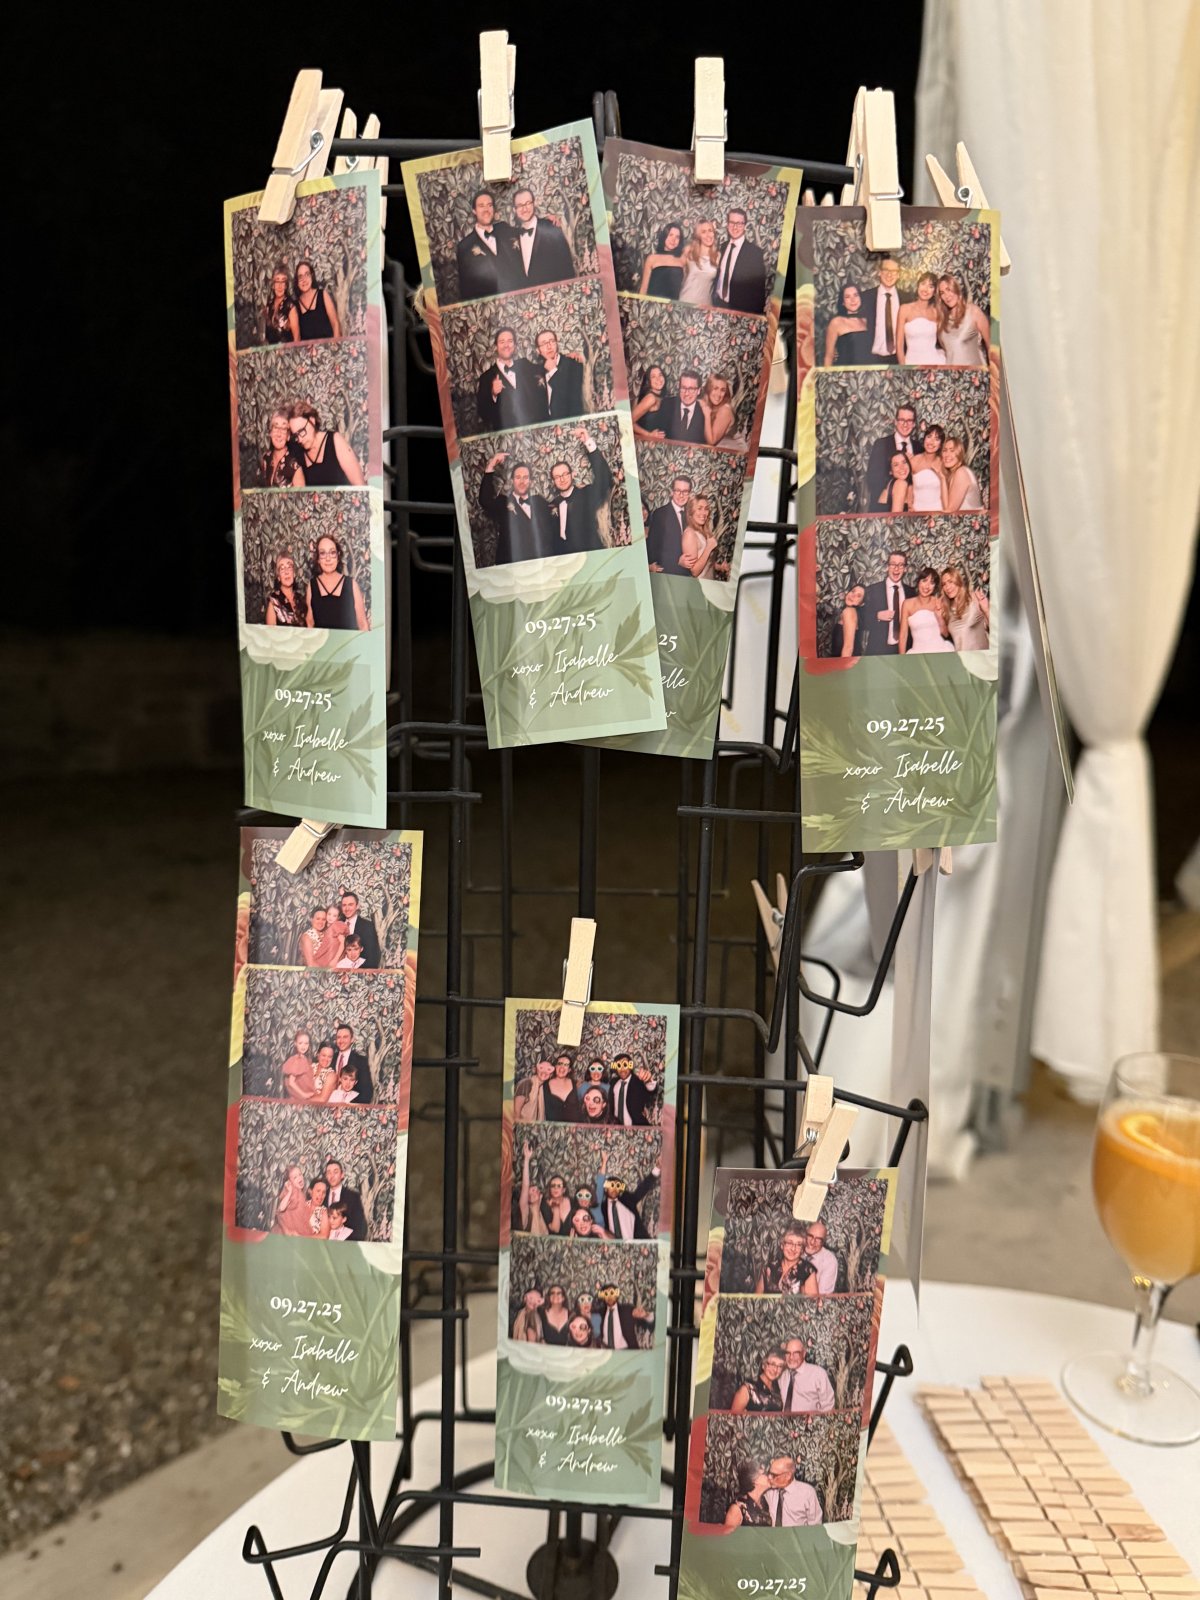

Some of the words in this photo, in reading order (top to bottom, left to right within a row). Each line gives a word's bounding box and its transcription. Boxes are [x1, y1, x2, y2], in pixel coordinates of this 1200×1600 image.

[525, 612, 597, 639] 09.27.25
[511, 662, 544, 678] xoxo
[554, 643, 619, 674] Isabelle
[275, 688, 332, 712] 09.27.25
[528, 688, 537, 709] &
[549, 679, 614, 709] Andrew
[262, 730, 286, 742] xoxo
[293, 724, 348, 751] Isabelle
[866, 716, 945, 740] 09.27.25
[273, 757, 280, 777] &
[288, 757, 341, 786] Andrew
[843, 765, 883, 779] xoxo
[893, 750, 963, 779] Isabelle
[860, 792, 871, 814] &
[883, 786, 954, 814] Andrew
[270, 1296, 342, 1324] 09.27.25
[249, 1337, 283, 1352] xoxo
[291, 1335, 360, 1364] Isabelle
[261, 1368, 271, 1389] &
[280, 1369, 349, 1400] Andrew
[545, 1395, 612, 1415] 09.27.25
[525, 1426, 558, 1440] xoxo
[566, 1424, 627, 1447] Isabelle
[538, 1451, 547, 1468] &
[557, 1451, 618, 1476] Andrew
[737, 1577, 807, 1596] 09.27.25
